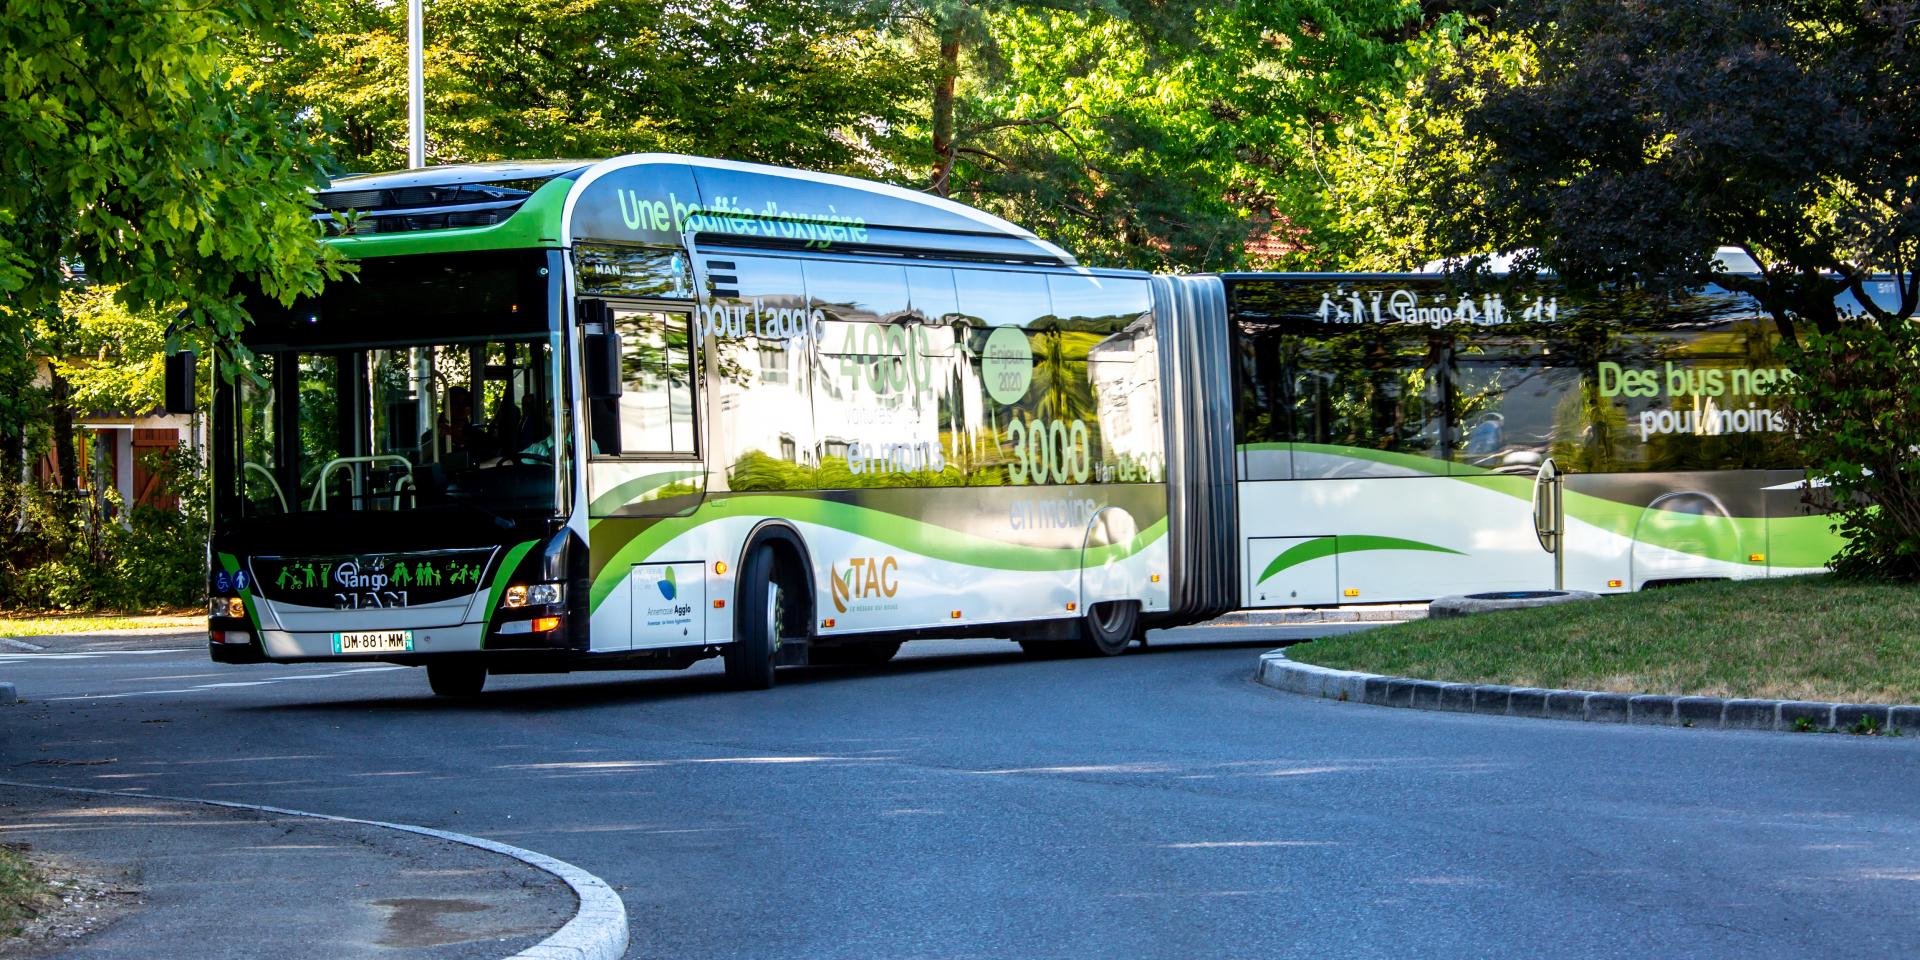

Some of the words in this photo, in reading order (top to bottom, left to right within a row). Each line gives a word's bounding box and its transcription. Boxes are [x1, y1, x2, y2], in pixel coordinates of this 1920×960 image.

[617, 188, 671, 232] Une
[670, 192, 758, 237] bouffée
[759, 201, 868, 248] d'oxygène
[594, 264, 621, 276] MAN
[695, 303, 749, 348] pour
[1394, 302, 1453, 330] Tango
[840, 324, 932, 394] 4000
[990, 344, 1024, 369] Enjeux
[998, 371, 1022, 392] 2020
[1599, 361, 1660, 398] Des
[1665, 361, 1726, 398] bus
[1732, 368, 1796, 397] neu
[1640, 409, 1703, 442] pour
[1707, 402, 1788, 434] moins
[847, 442, 875, 475] en
[880, 432, 945, 473] moins
[1007, 419, 1089, 485] 3000
[1119, 452, 1137, 482] de
[1009, 499, 1033, 529] en
[1038, 488, 1096, 528] moins
[340, 571, 388, 591] Tango
[849, 556, 898, 598] TAC
[674, 603, 692, 617] Agglo
[343, 633, 404, 649] DM-881-MM
